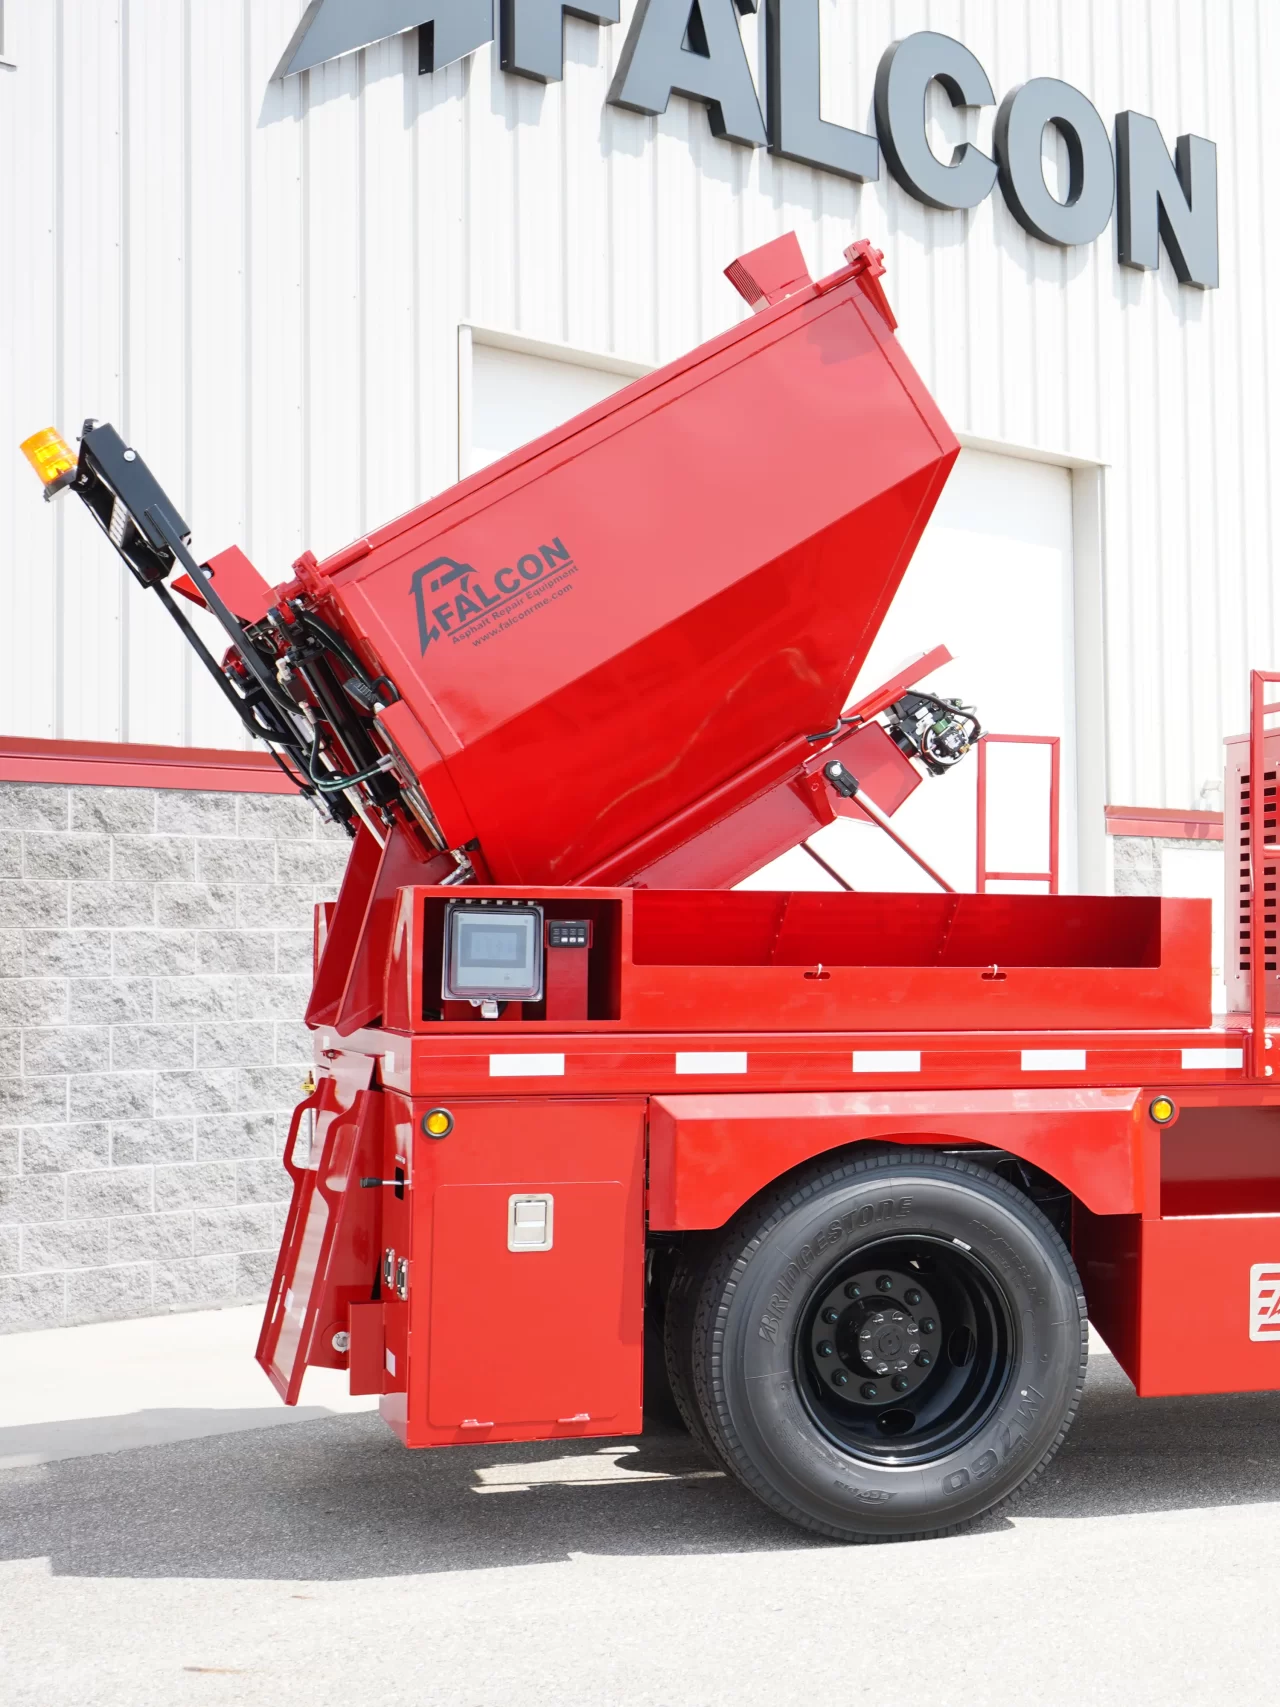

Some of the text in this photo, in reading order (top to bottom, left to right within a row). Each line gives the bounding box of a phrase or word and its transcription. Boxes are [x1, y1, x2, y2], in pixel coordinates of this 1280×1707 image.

[432, 536, 571, 632] FALCON
[452, 565, 579, 644] Asphalt Repair Equipment
[472, 583, 573, 647] www.falconrme.com
[758, 1195, 914, 1346] BRIDGESTONE
